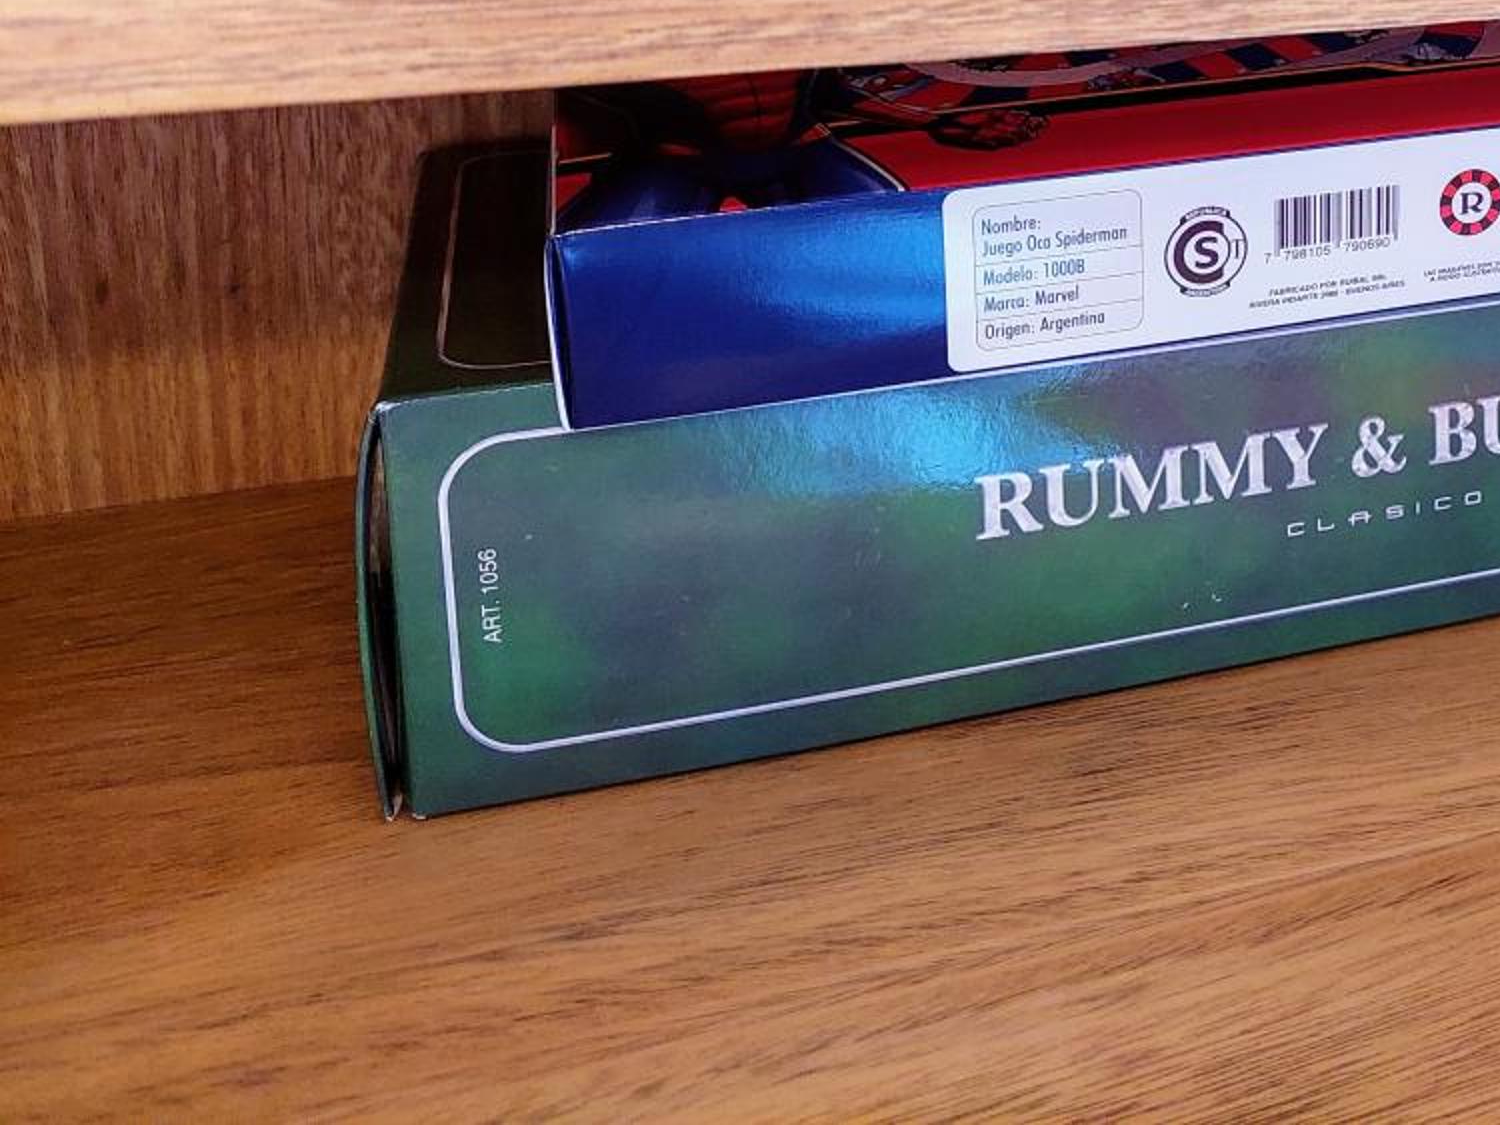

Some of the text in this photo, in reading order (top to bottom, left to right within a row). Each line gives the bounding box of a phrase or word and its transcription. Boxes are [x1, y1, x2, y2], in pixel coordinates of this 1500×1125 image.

[1459, 192, 1485, 215] R
[981, 216, 1041, 235] Nombre:
[982, 226, 1127, 258] Juego Oca Spiderman
[1264, 236, 1391, 264] 7 798105 790690
[983, 259, 1085, 286] Modelo: 1000B
[984, 286, 1079, 312] Marca: Marvel
[985, 312, 1105, 343] Origen: Argentina
[974, 423, 1329, 542] RUMMY
[1352, 415, 1408, 478] &
[1286, 489, 1484, 537] CLASICO
[477, 548, 503, 643] ART. 1056
